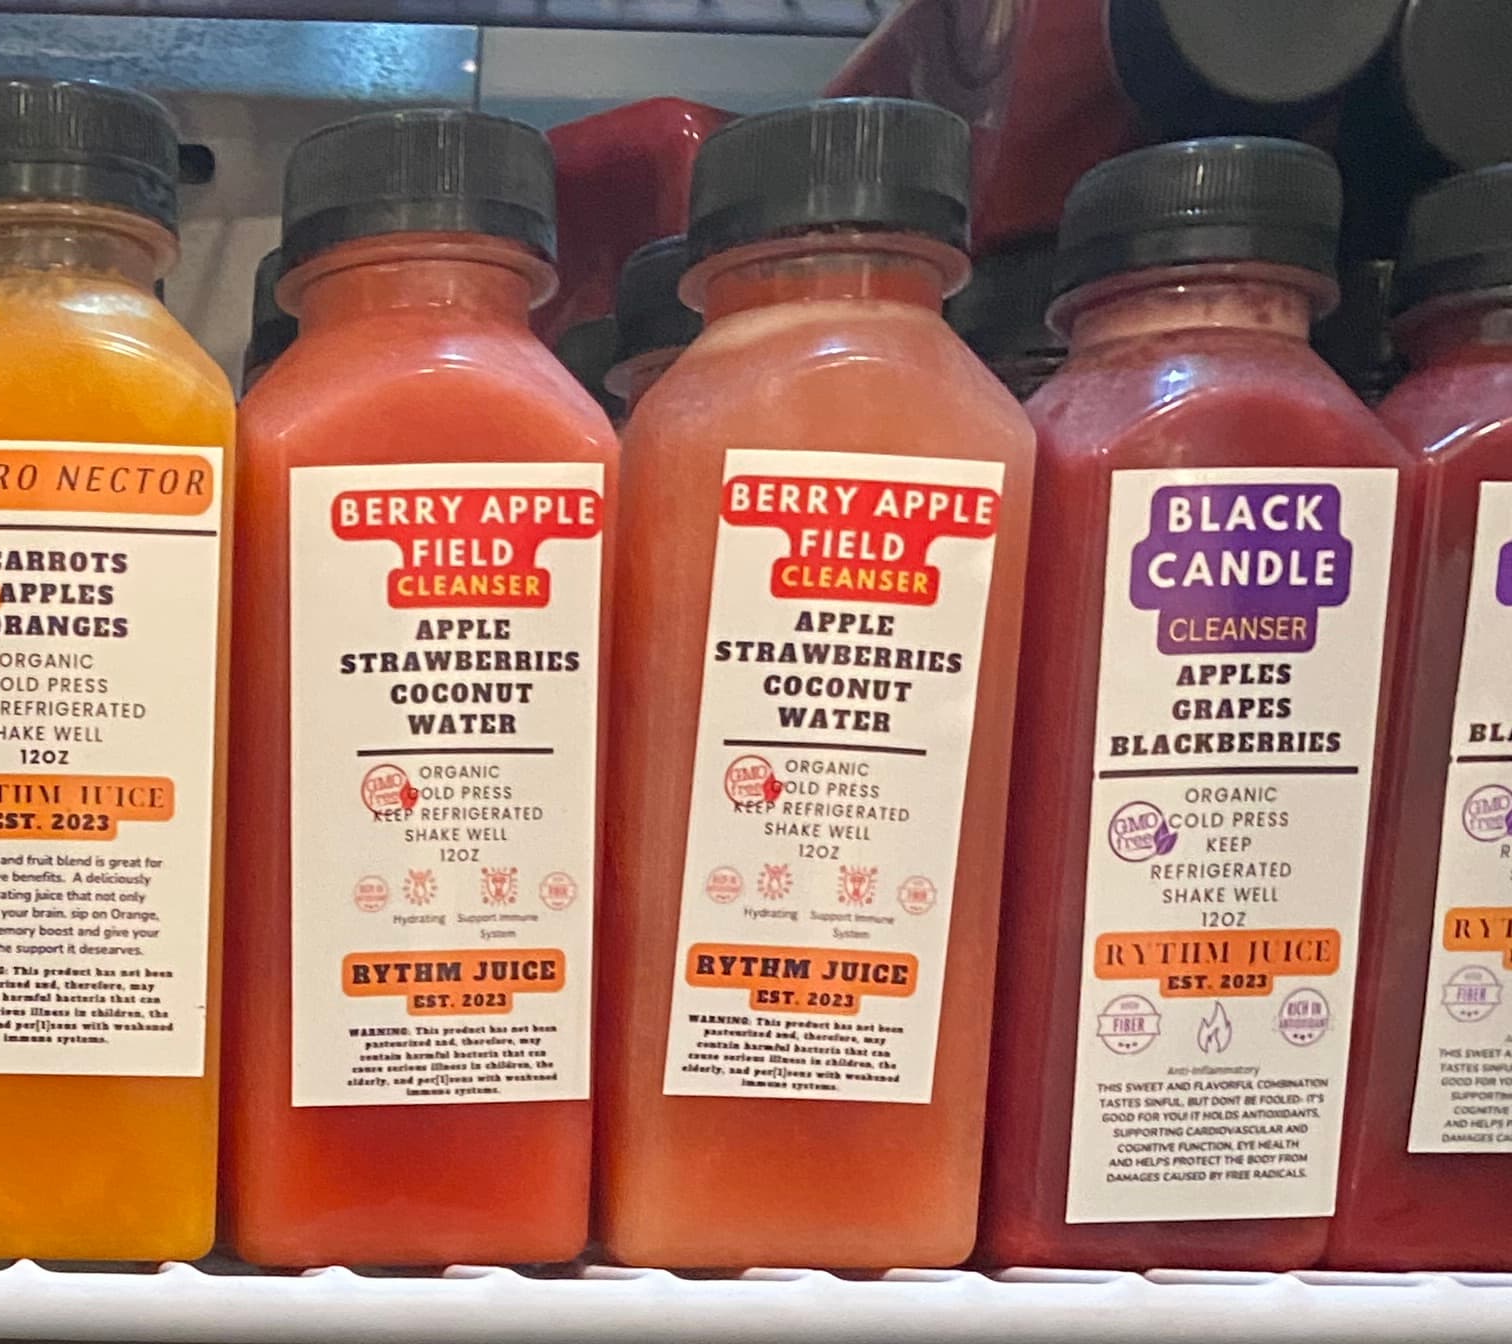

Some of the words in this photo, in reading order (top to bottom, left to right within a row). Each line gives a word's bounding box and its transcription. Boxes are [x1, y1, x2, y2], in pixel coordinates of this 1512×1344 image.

[56, 465, 205, 496] NECTOR
[341, 496, 462, 526] BERRY
[481, 496, 595, 525] APPLE
[731, 483, 859, 514] BERRY
[874, 488, 994, 525] APPLE
[1168, 495, 1323, 533] BLACK
[412, 539, 513, 566] FIELD
[799, 529, 904, 561] FIELD
[781, 565, 929, 594] CLEANSER
[1147, 550, 1337, 588] CANDLE
[397, 575, 541, 596] CLEANSER
[794, 611, 895, 636] APPLE
[1169, 617, 1308, 642] CLEANSER
[340, 651, 580, 674] STRAWBERRIES
[714, 641, 963, 673] STRAWBERRIES
[1176, 663, 1292, 686] APPLES
[390, 683, 533, 704] COCONUT
[1171, 697, 1292, 720] GRAPES
[407, 714, 517, 735] WATER
[1110, 731, 1342, 757] BLACKBERRIES
[20, 750, 69, 764] 12OZ
[1206, 837, 1252, 852] KEEP
[1150, 862, 1292, 880] REFRIGERATED
[352, 962, 462, 985] RYTHM
[473, 960, 556, 982] JUICE
[756, 990, 799, 1004] EST.
[807, 992, 855, 1007] 2023
[1457, 986, 1487, 1002] FIBER
[1113, 1018, 1145, 1034] FIBER
[1106, 1171, 1160, 1184] DAMAGES
[1163, 1170, 1207, 1181] CAUSED
[1209, 1170, 1223, 1181] BY
[1225, 1169, 1251, 1181] FREE
